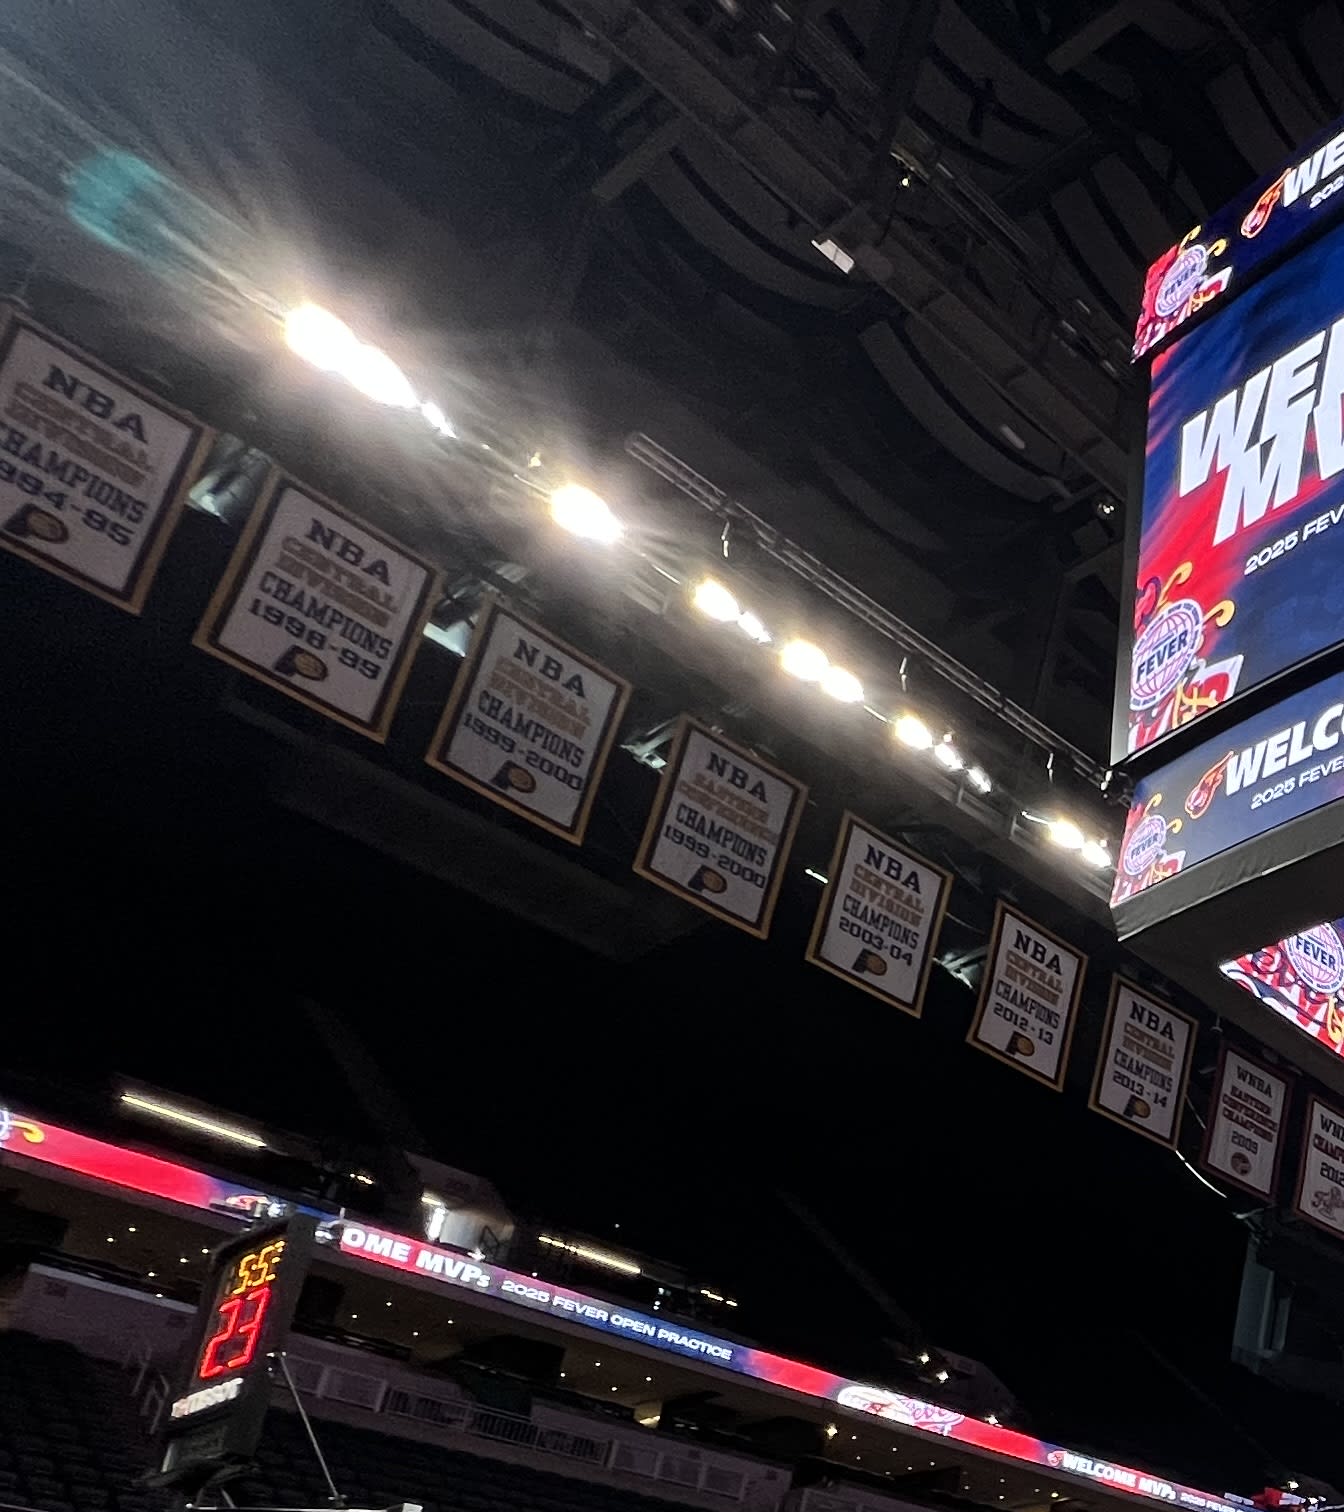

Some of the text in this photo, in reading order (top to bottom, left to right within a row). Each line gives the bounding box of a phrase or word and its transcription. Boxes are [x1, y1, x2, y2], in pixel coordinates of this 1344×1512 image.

[43, 364, 148, 444] NBA
[0, 459, 135, 546] 994-95
[306, 517, 391, 586] NBA
[1243, 531, 1300, 577] 2025
[259, 570, 393, 660] CHAMPIONS
[513, 638, 585, 698] NBA
[1134, 634, 1189, 678] FEVER
[463, 712, 584, 791] 1999-2000
[478, 689, 585, 768] CHAMPIONS
[705, 751, 768, 803] NBA
[1250, 778, 1296, 809] 2025
[663, 825, 766, 889] 1999-2000
[676, 804, 768, 867] CHAMPIONS
[864, 844, 922, 894] NBA
[839, 917, 913, 967] 2003-04
[842, 894, 920, 950] CHAMPIONS
[1014, 929, 1062, 976] NBA
[1295, 936, 1337, 971] FEVER
[995, 980, 1061, 1030] CHAMPIONS
[1130, 1000, 1175, 1042] NBA
[1114, 1048, 1173, 1093] CHAMPIONS
[1236, 1065, 1273, 1098] WNBA
[416, 1248, 734, 1361] MVPs 2025 FEVER OPEN PRACTICE
[200, 1286, 273, 1379] 23
[1062, 1451, 1137, 1487] WELCOME
